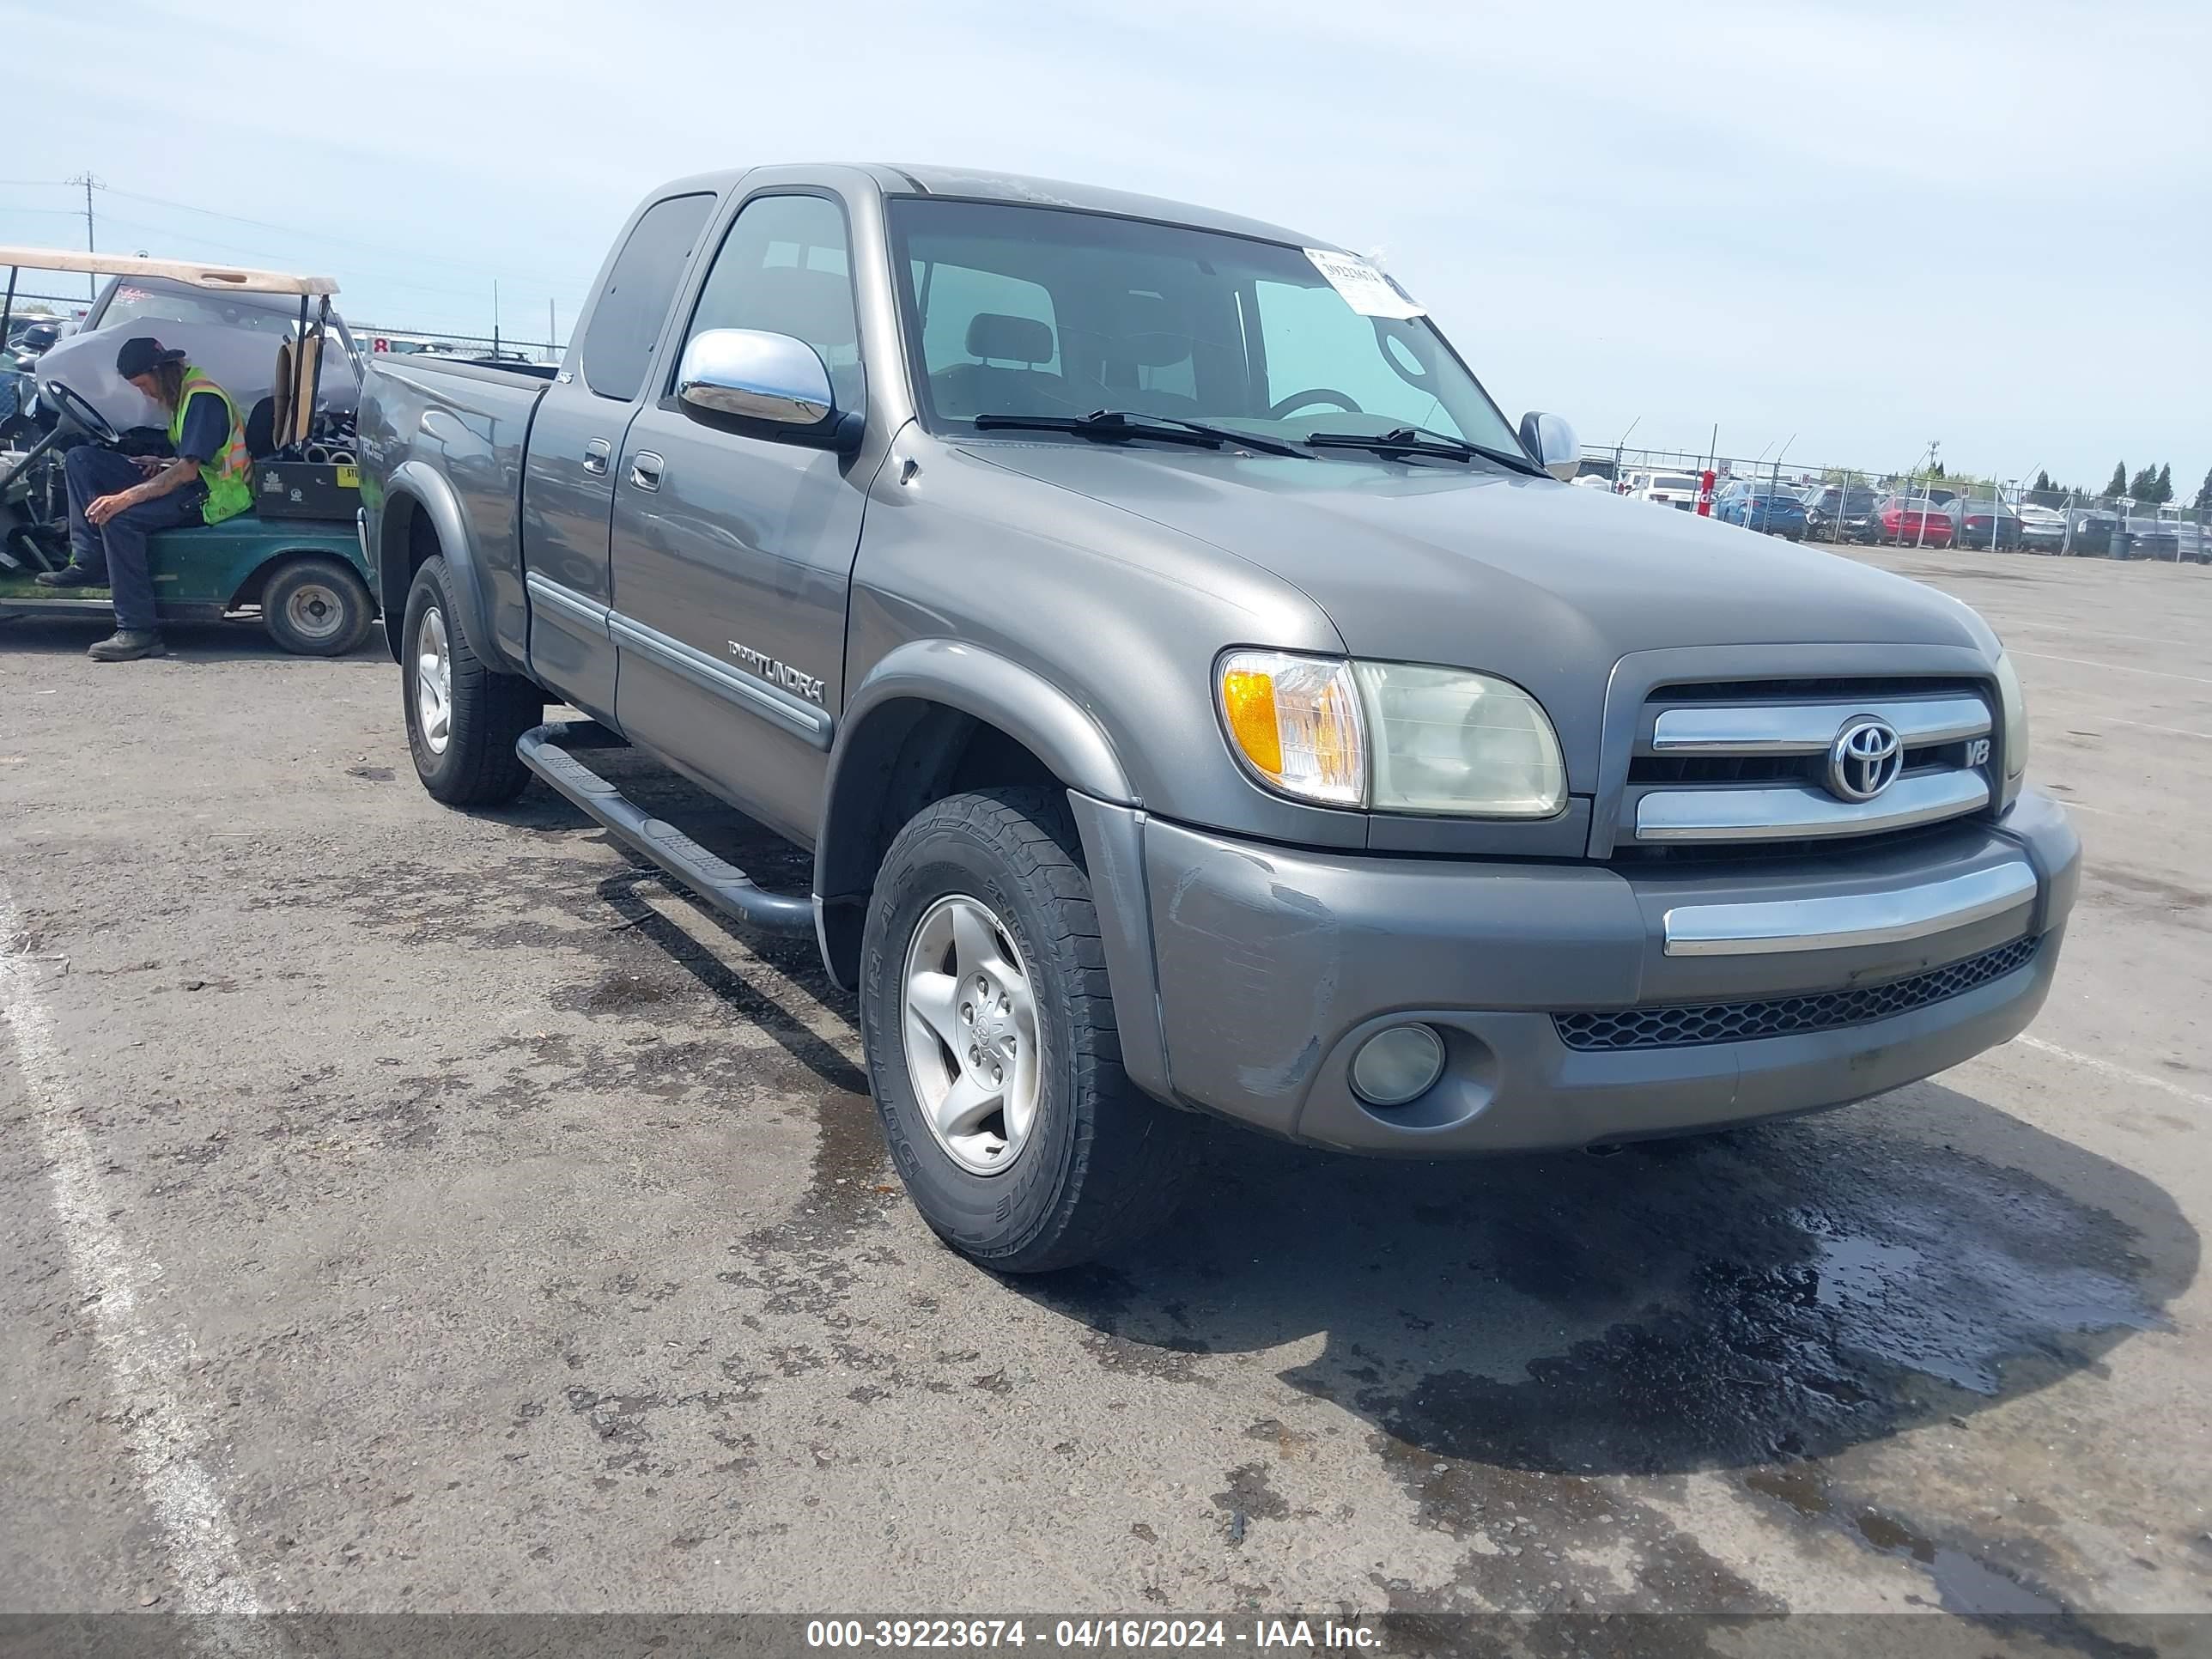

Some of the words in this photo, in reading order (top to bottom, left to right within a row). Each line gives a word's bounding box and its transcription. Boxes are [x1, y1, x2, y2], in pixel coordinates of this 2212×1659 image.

[728, 640, 757, 665] TOYOTA
[756, 652, 825, 704] TUNDRA
[1965, 738, 1990, 768] V8
